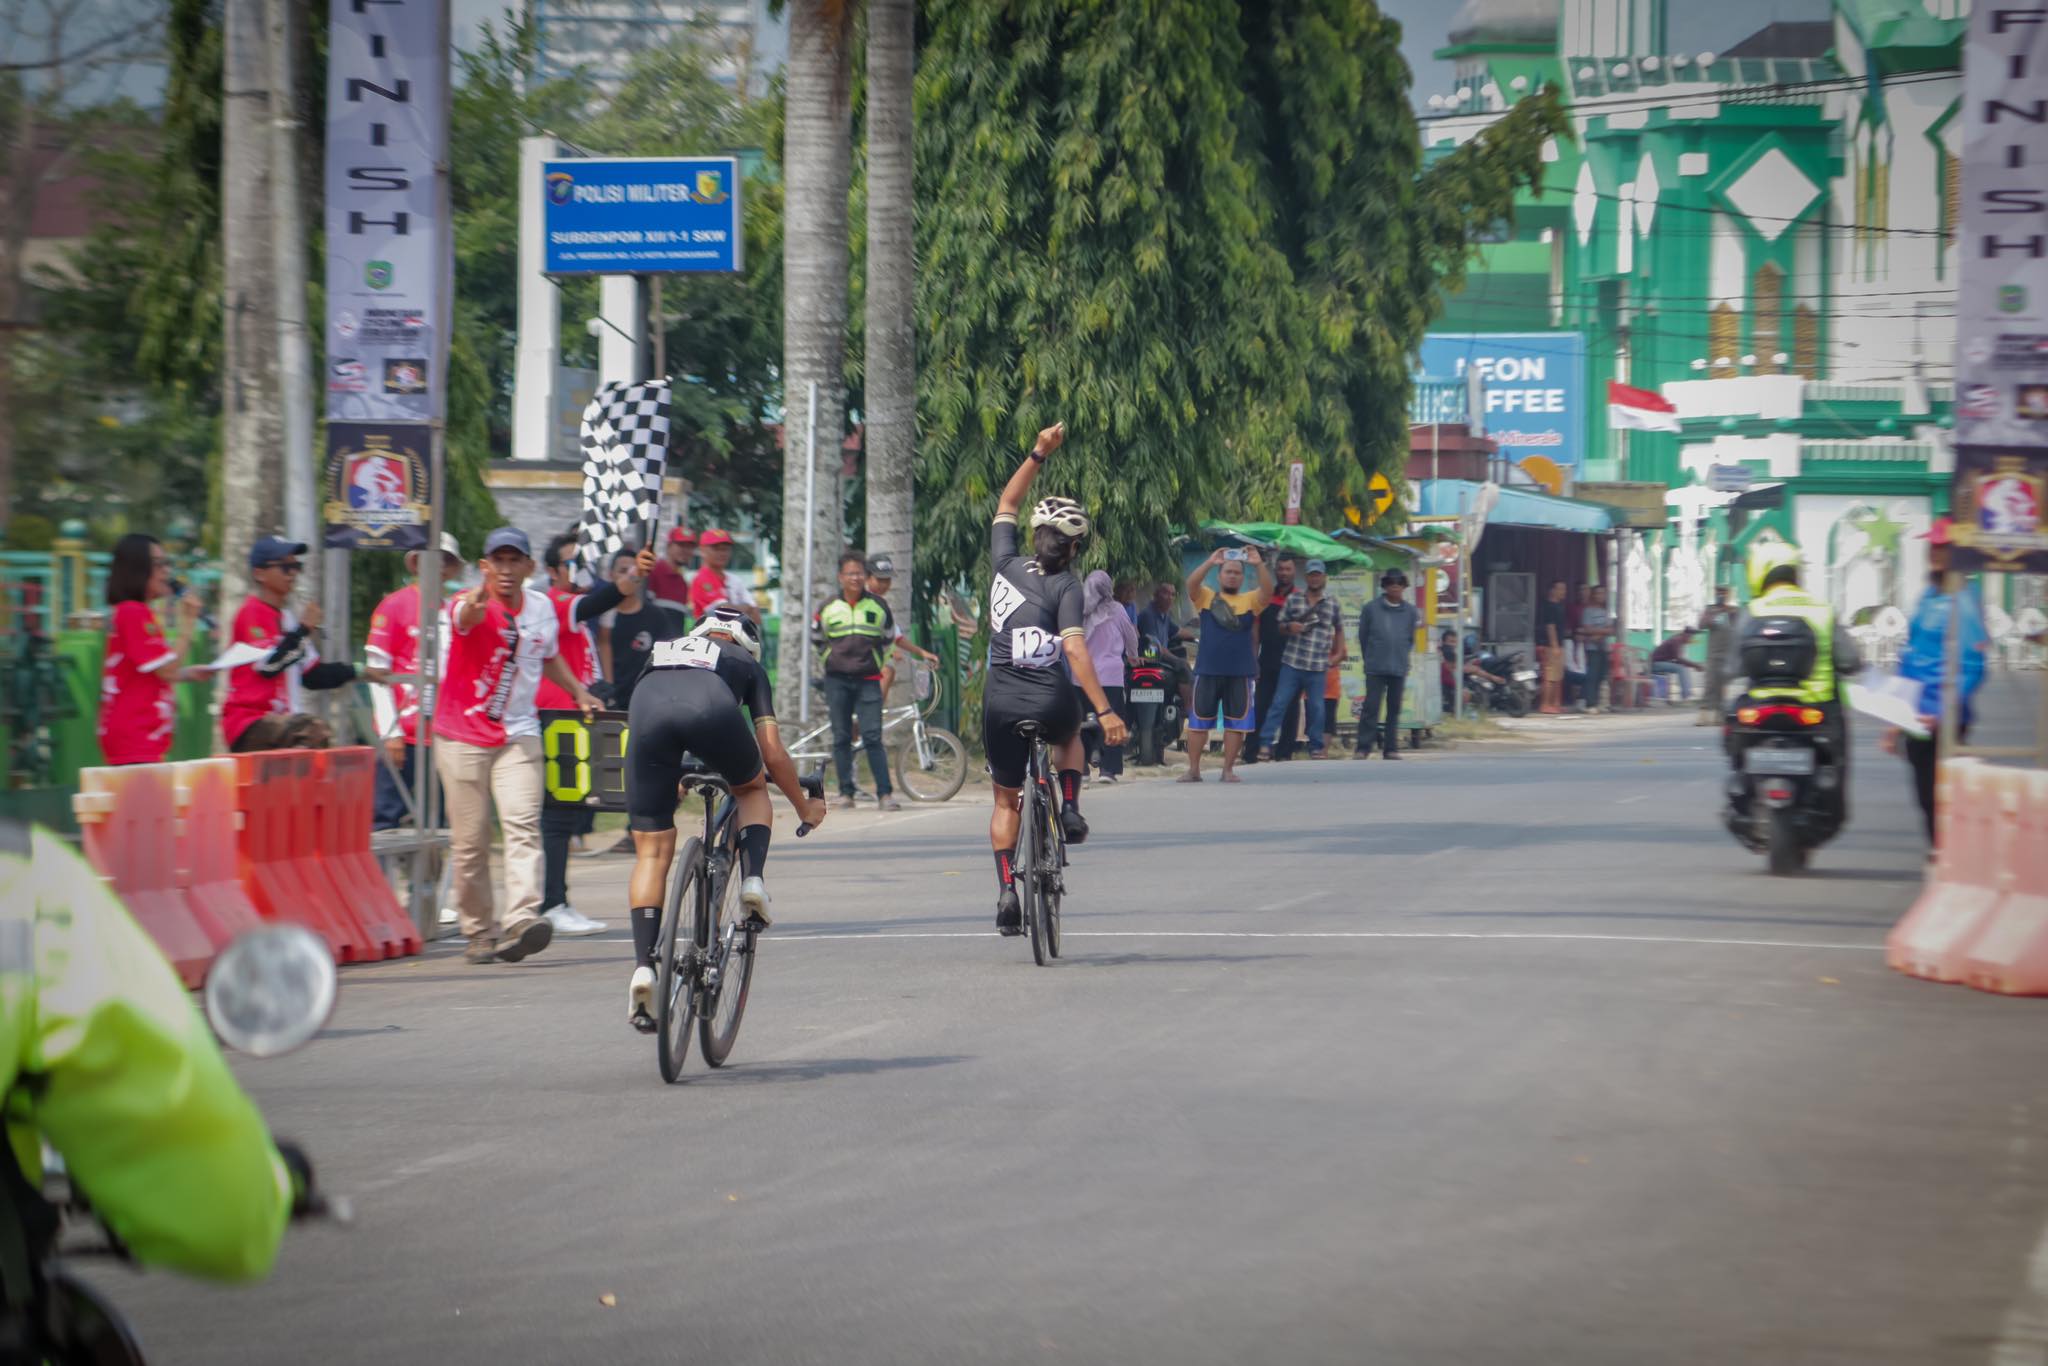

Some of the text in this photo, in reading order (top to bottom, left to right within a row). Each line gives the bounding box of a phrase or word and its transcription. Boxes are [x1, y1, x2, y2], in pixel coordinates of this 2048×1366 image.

[1981, 9, 2048, 260] FINISH
[574, 183, 690, 204] POLISI MILITER
[1439, 387, 1566, 414] CFFEE
[1019, 629, 1056, 659] 123
